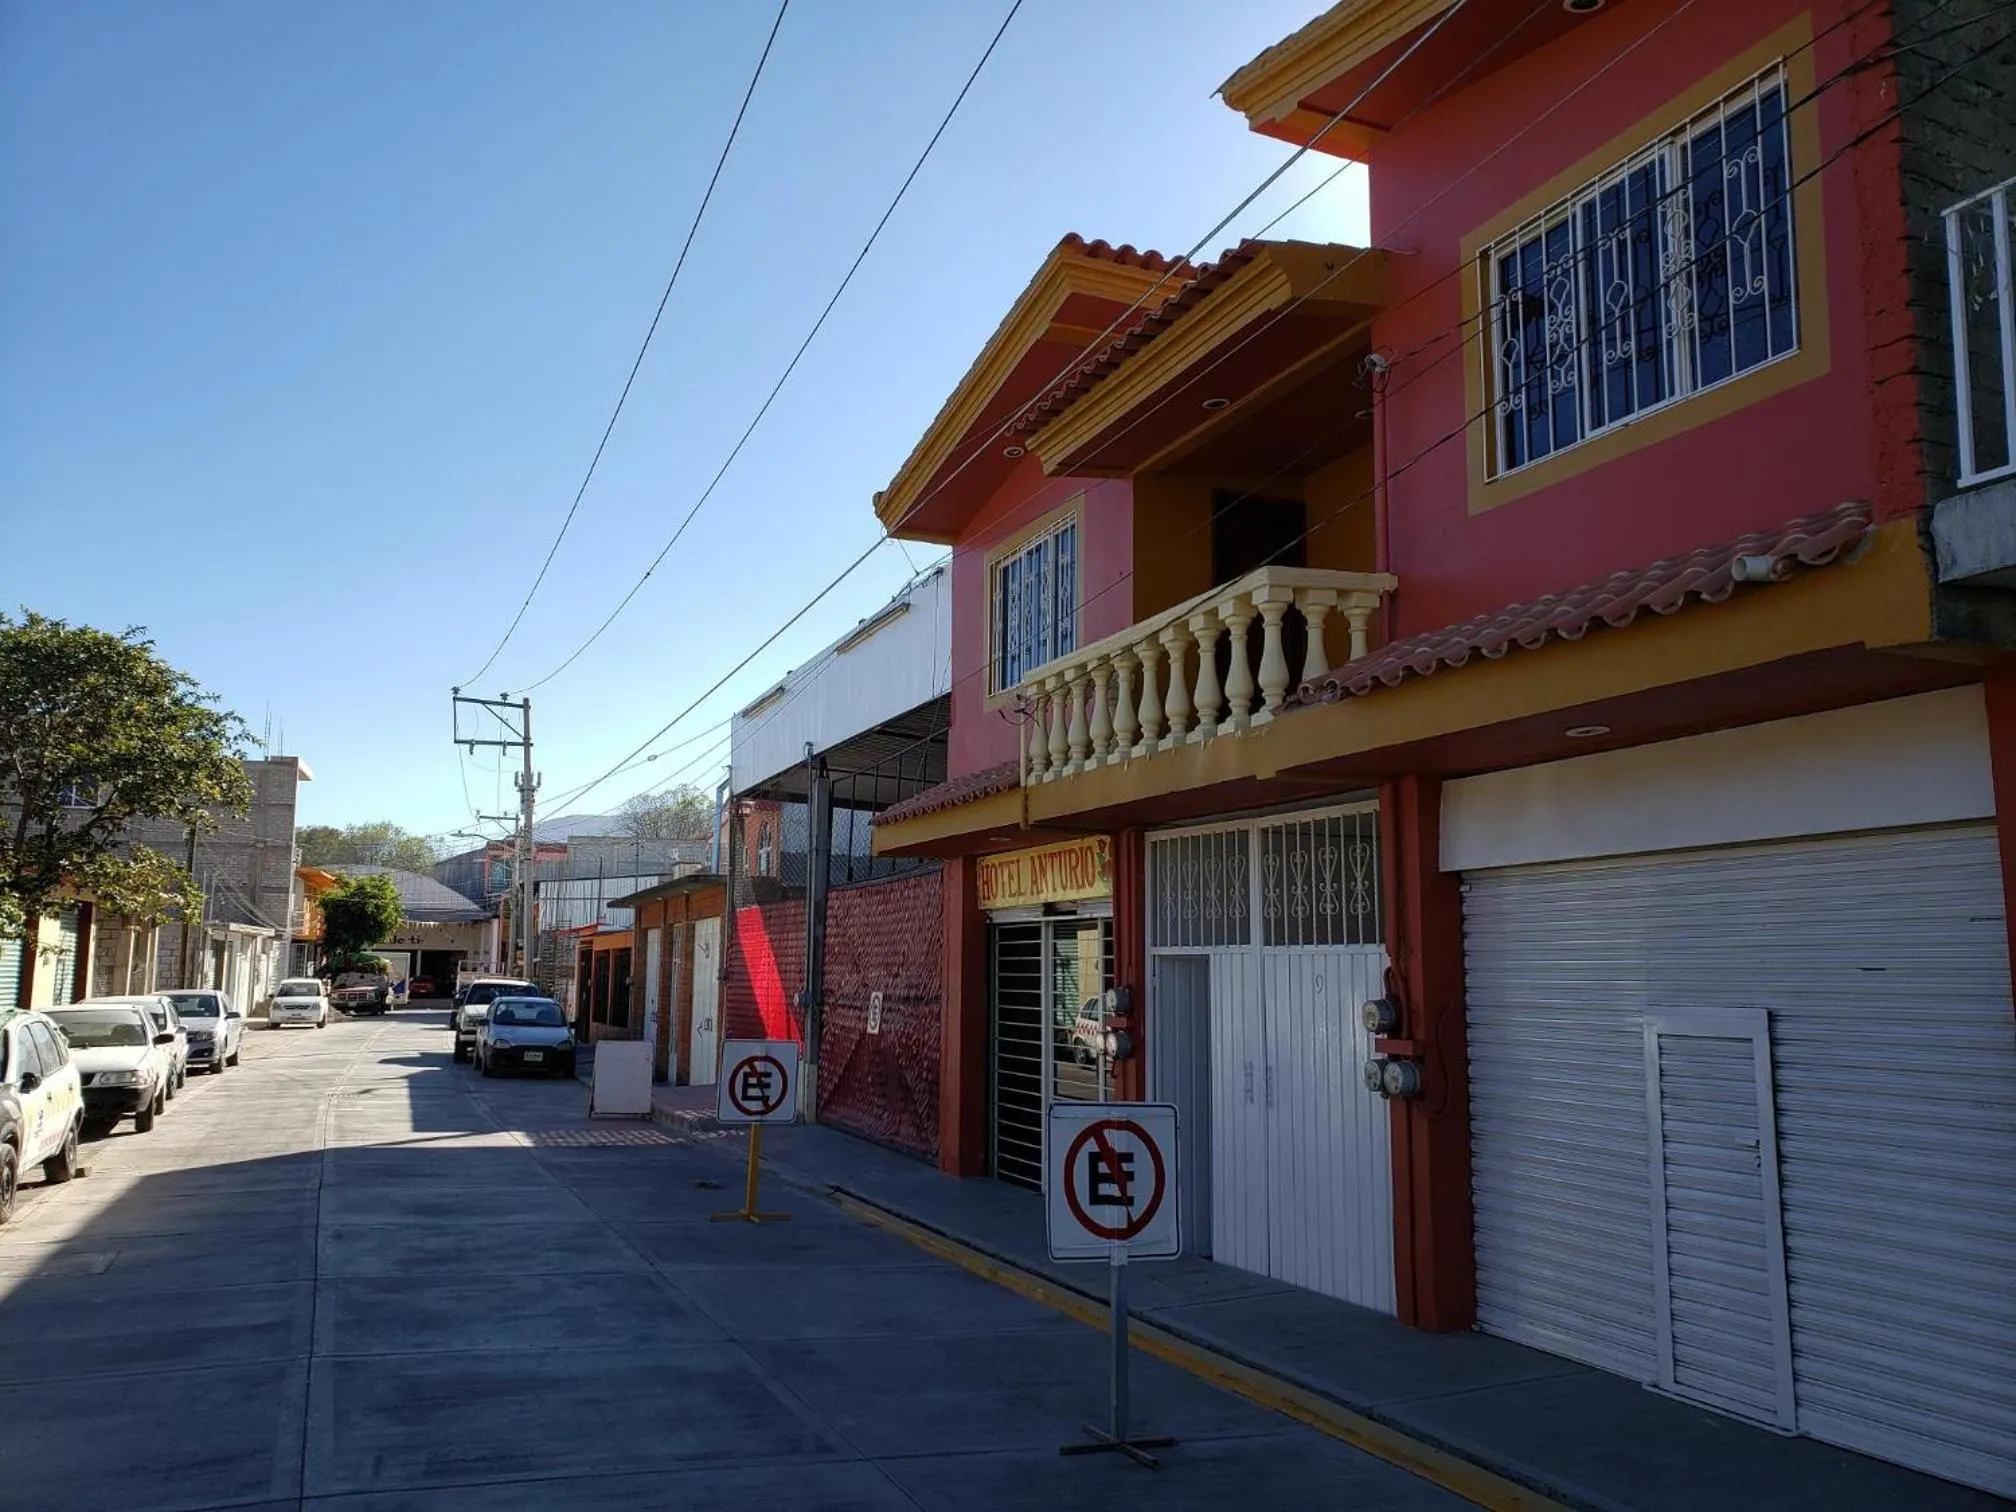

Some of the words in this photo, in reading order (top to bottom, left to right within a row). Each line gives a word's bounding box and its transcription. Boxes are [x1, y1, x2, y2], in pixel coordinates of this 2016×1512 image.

[981, 859, 1025, 900] HOTEL
[1030, 845, 1096, 896] ANTURIO
[741, 1071, 772, 1102] E
[1088, 1151, 1135, 1206] E
